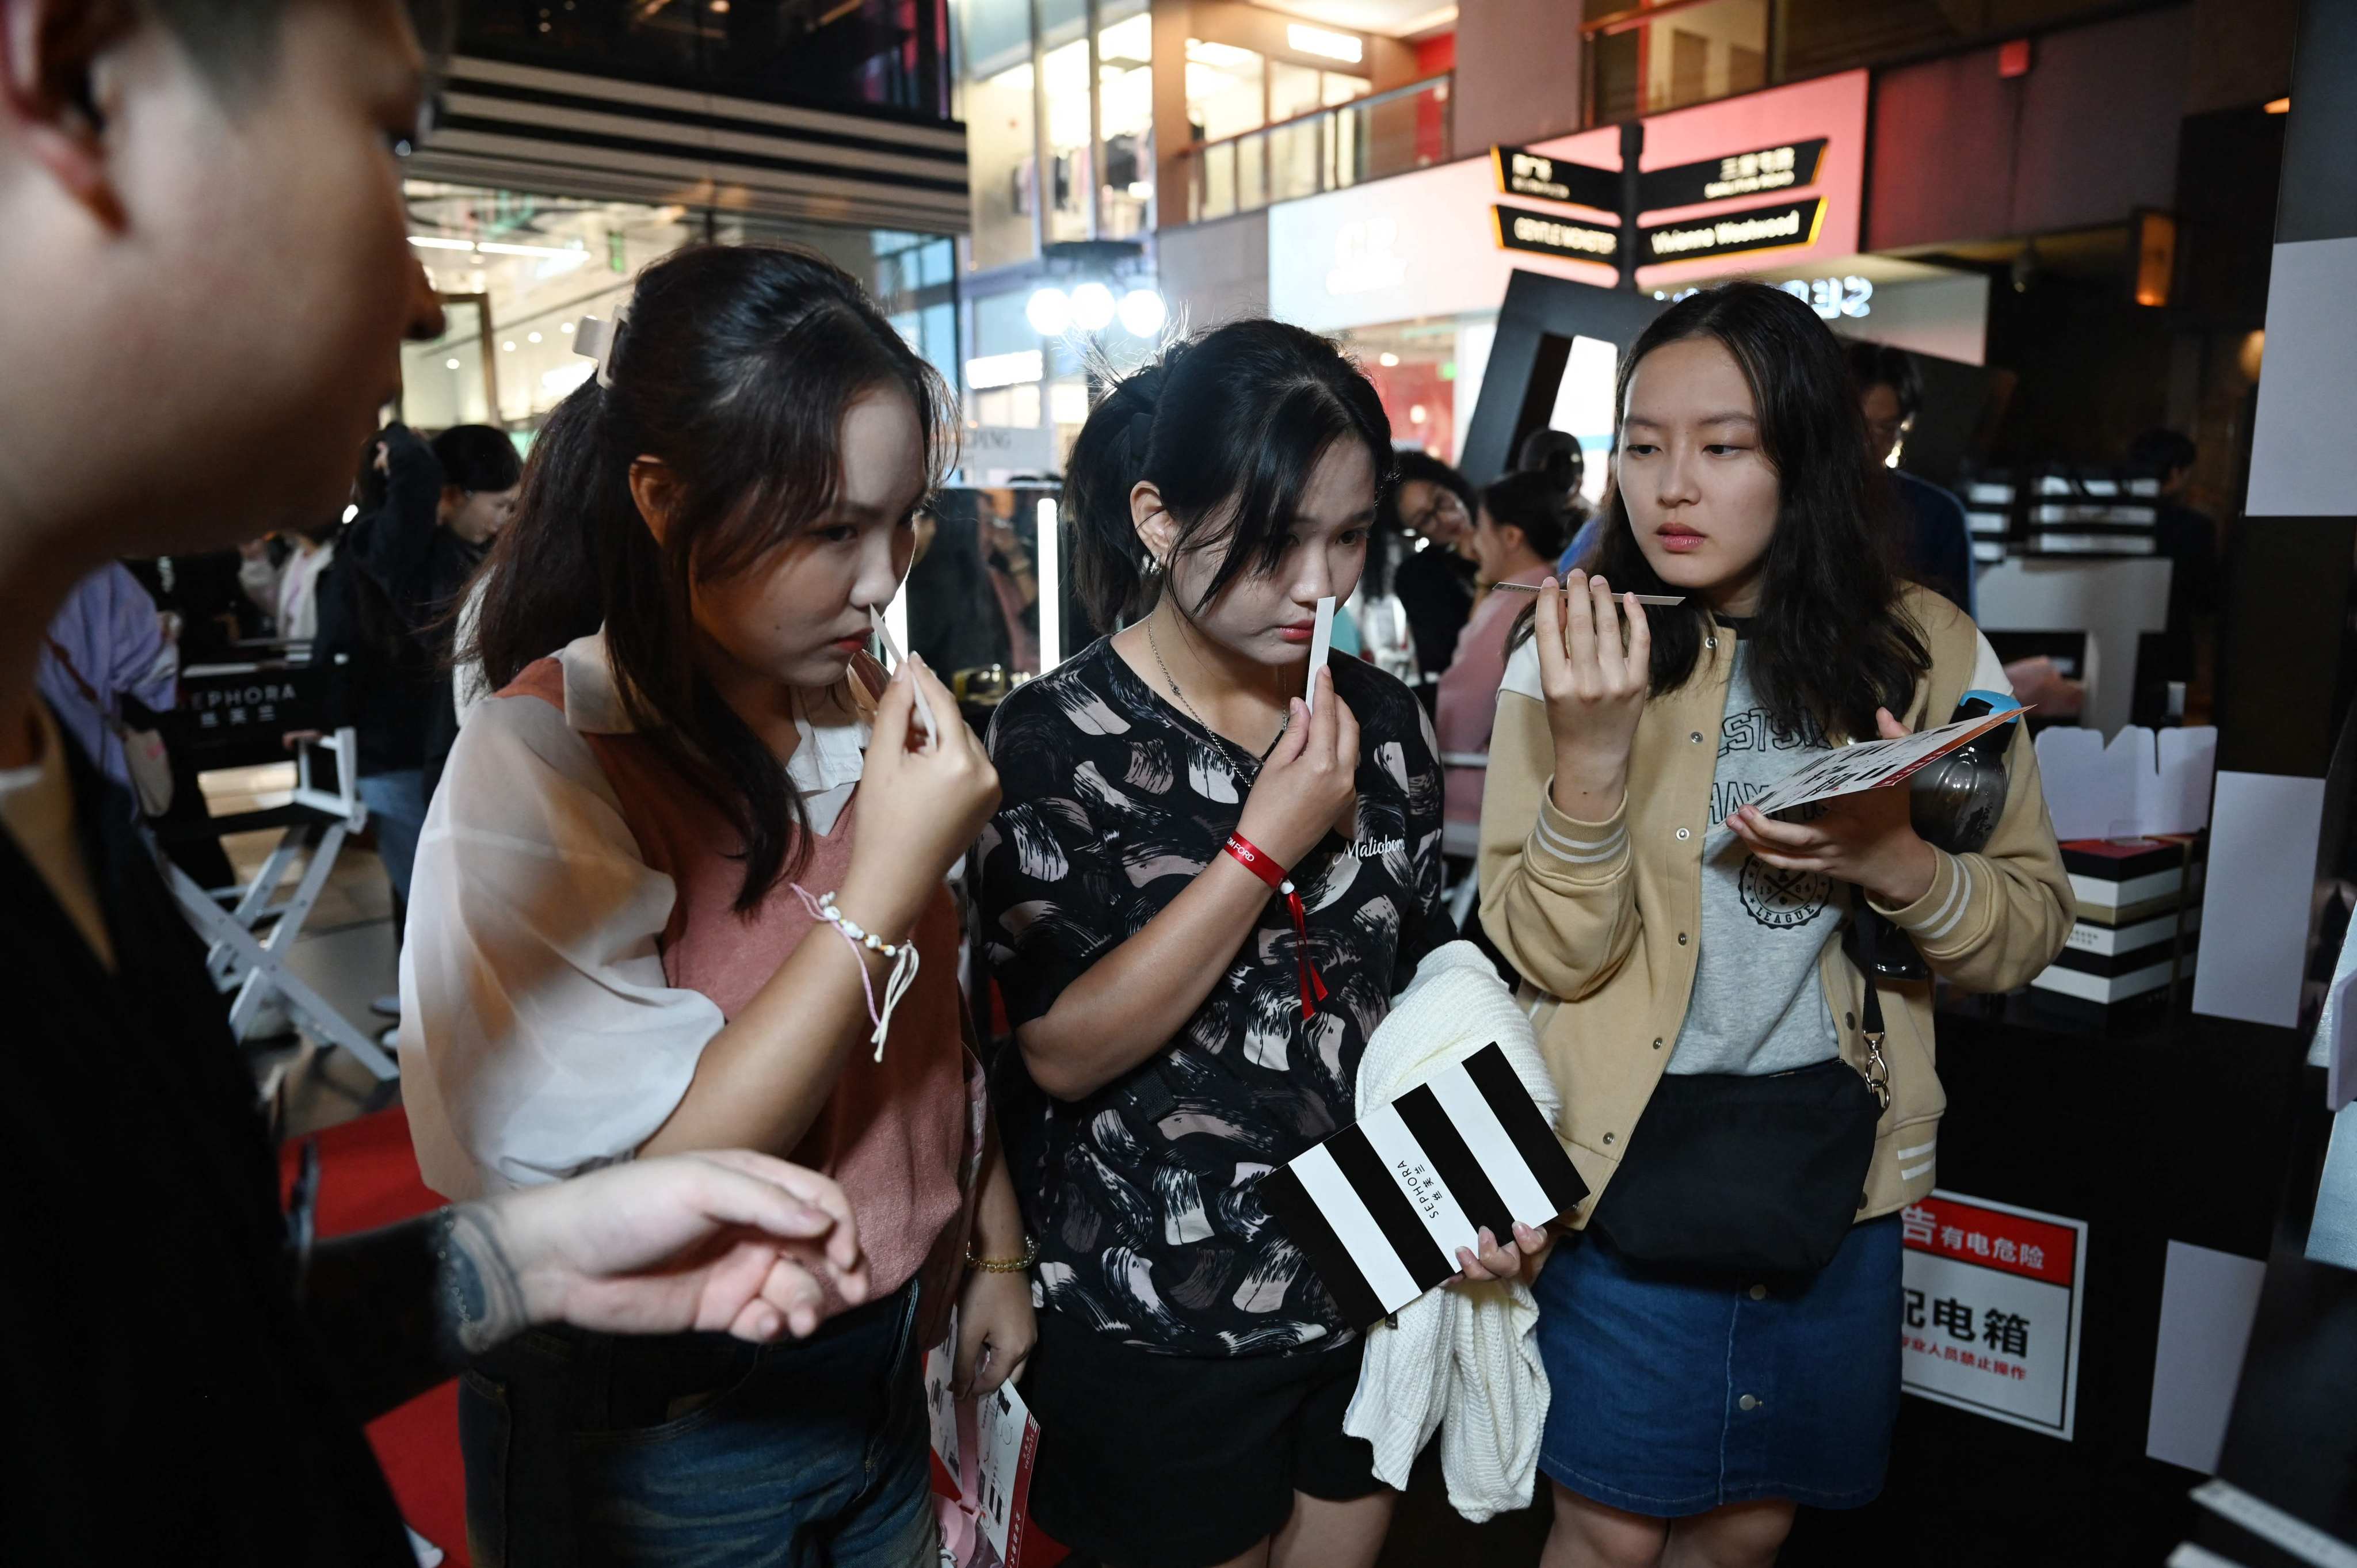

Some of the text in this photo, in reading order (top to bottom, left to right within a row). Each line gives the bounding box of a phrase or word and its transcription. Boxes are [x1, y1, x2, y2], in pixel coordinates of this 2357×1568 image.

[190, 683, 297, 711] EPHORA
[1233, 843, 1254, 861] FORD
[1756, 905, 1814, 923] LEAGUE
[1397, 1160, 1439, 1218] SEPHORA
[1414, 1164, 1443, 1200] 丝芙兰
[1901, 1205, 2045, 1270] 告 有电危险
